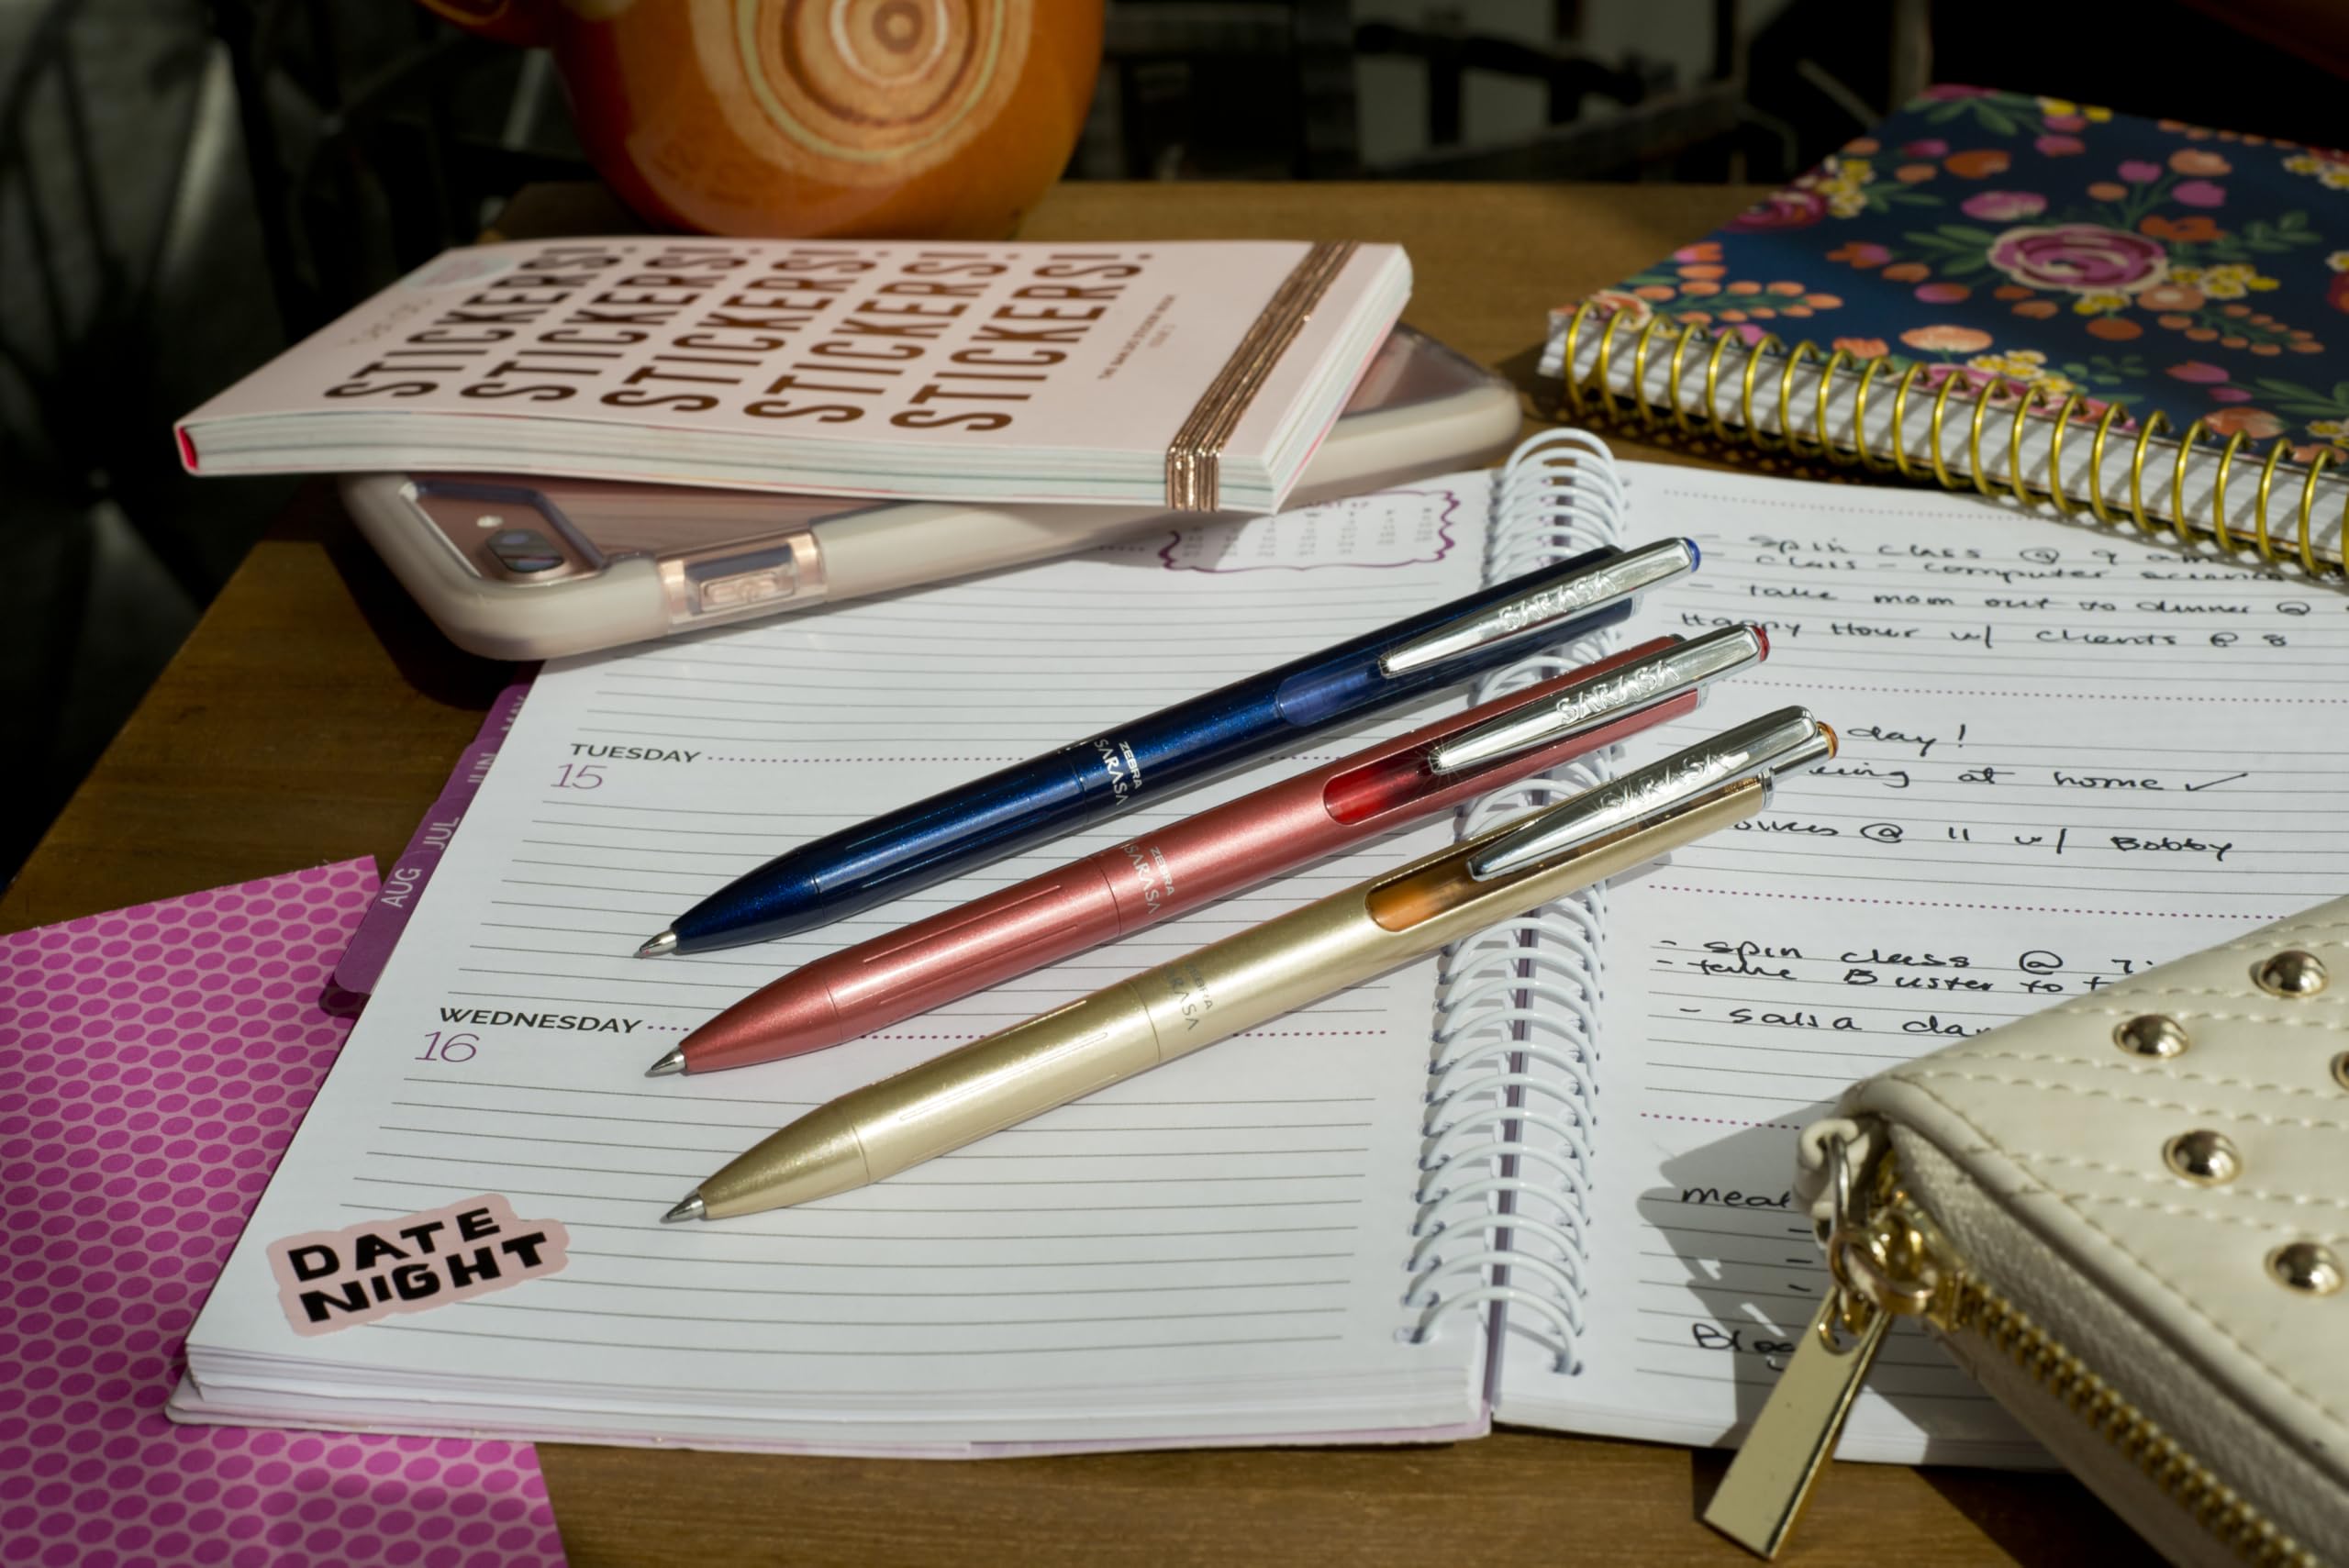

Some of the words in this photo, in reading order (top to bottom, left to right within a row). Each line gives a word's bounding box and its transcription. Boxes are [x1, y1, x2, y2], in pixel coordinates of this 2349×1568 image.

[323, 246, 637, 398] STICKERS!
[460, 247, 763, 401] STICKERS!
[600, 249, 891, 412] STICKERS!
[742, 250, 1020, 423] STICKERS!
[889, 253, 1152, 431] STICKERS!
[1924, 562, 2110, 584] computer
[2020, 548, 2060, 563] @
[1499, 570, 1616, 631] SARASA
[1875, 595, 1955, 606] mom
[1986, 596, 2059, 610] out
[2136, 599, 2251, 614] dinner
[2276, 601, 2311, 616] @
[1831, 622, 1920, 639] Hour
[1951, 624, 1993, 649] w/
[2210, 631, 2239, 647] @
[2262, 633, 2287, 647] 8
[1556, 659, 1680, 724] SARASA
[570, 742, 701, 763] TUESDAY
[1094, 738, 1130, 806] SARASA
[1119, 740, 1142, 790] ZEBRA
[550, 762, 607, 790] 15
[1957, 767, 2016, 784] at
[2054, 771, 2165, 791] home
[422, 817, 461, 851] JUL
[1859, 822, 1904, 843] @
[1948, 827, 1971, 842] 11
[2014, 827, 2067, 854] w/
[2110, 833, 2233, 862] Bobby
[381, 867, 423, 908] AUG
[1123, 844, 1161, 915] SARASA
[1150, 846, 1175, 896] ZEBRA
[1687, 958, 1798, 981] take
[1843, 968, 1995, 992] Buster
[2019, 979, 2065, 994] to
[1841, 948, 1971, 968] class
[2019, 950, 2065, 975] @
[1162, 963, 1199, 1031] RASA
[440, 1006, 642, 1034] WEDNESDAY
[1728, 1007, 1863, 1030] salsa
[414, 1030, 480, 1063] 16
[287, 1207, 501, 1283] DATE
[298, 1230, 547, 1323] NIGHT
